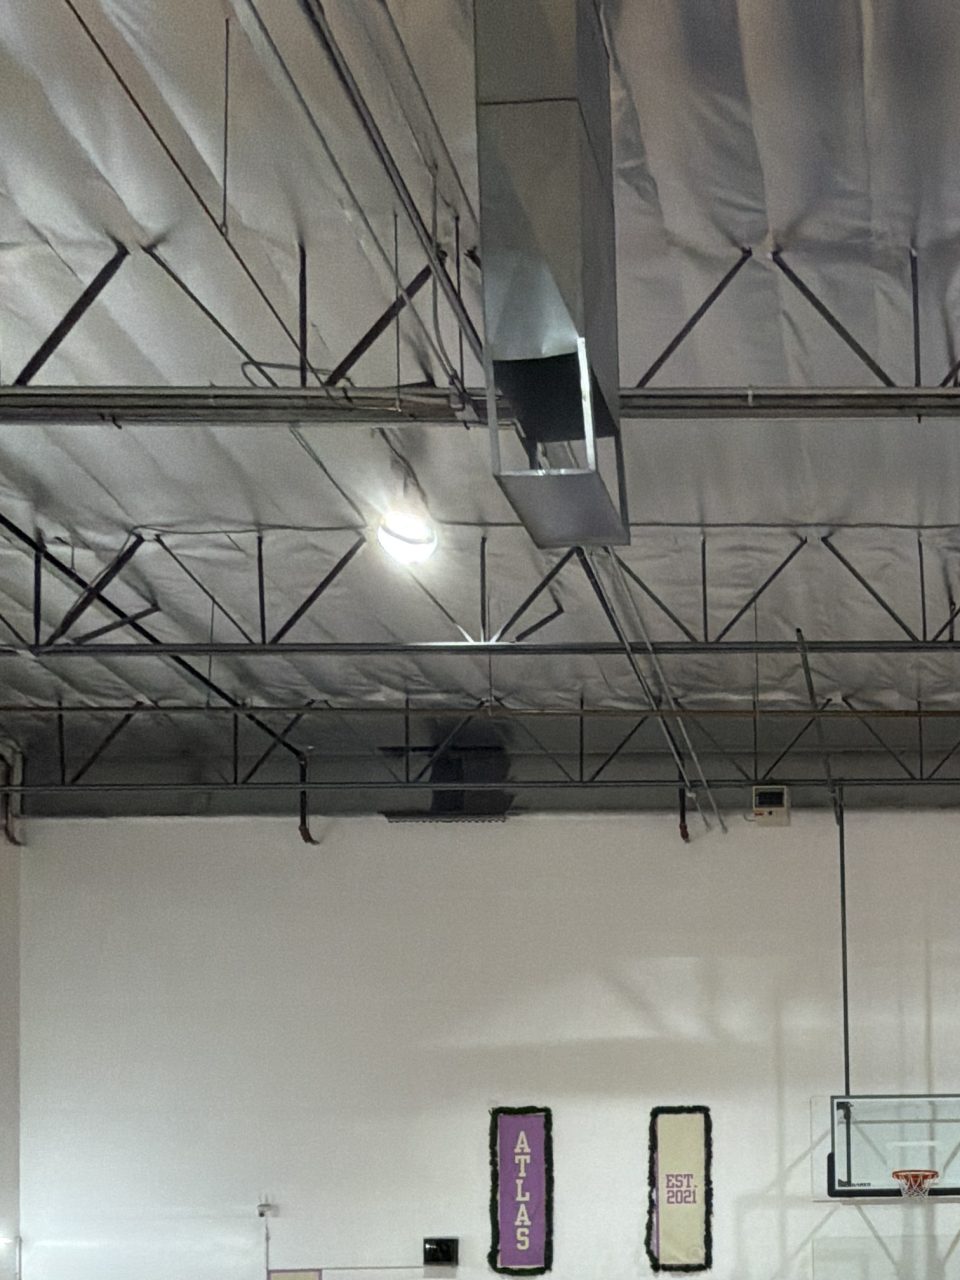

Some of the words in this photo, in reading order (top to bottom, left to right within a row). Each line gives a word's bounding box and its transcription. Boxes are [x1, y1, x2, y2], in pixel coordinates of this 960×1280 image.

[665, 1174, 698, 1188] EST.
[514, 1131, 531, 1250] ATLAS
[666, 1190, 697, 1204] 2021
